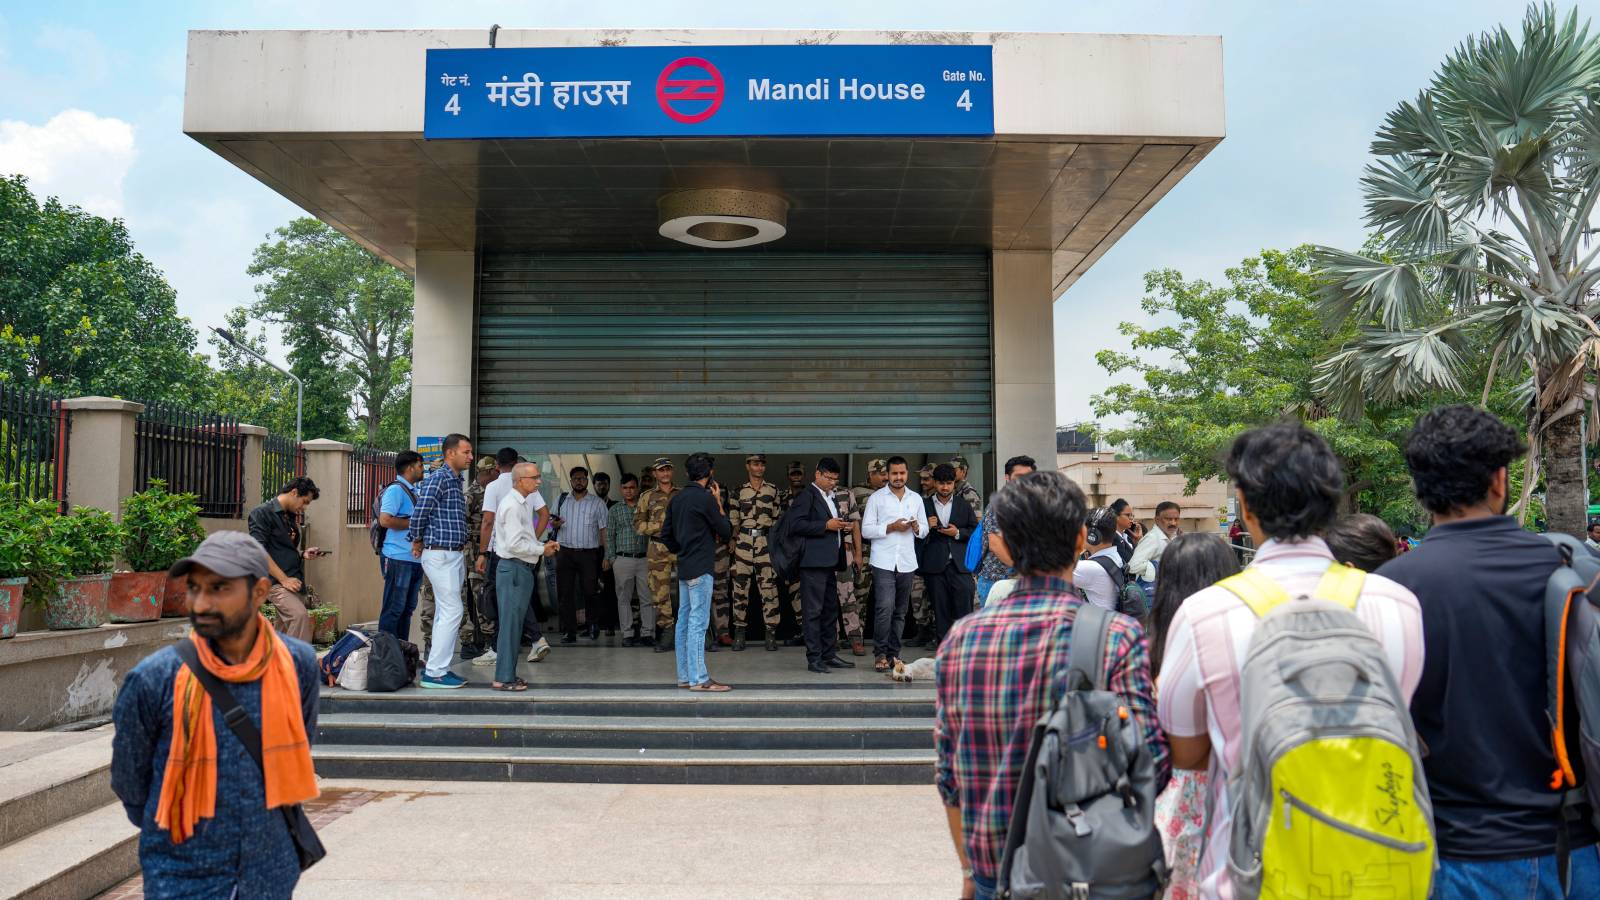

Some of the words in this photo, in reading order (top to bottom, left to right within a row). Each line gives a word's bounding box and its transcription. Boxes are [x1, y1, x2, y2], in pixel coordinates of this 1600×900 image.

[440, 73, 458, 87] गेट
[458, 73, 471, 86] नं.
[942, 70, 966, 82] Gate
[968, 70, 986, 82] No.
[485, 72, 544, 107] मंडी
[550, 80, 631, 110] हाउस
[748, 78, 830, 101] Mandi
[839, 78, 926, 101] House
[956, 89, 973, 112] 4
[444, 93, 461, 116] 4
